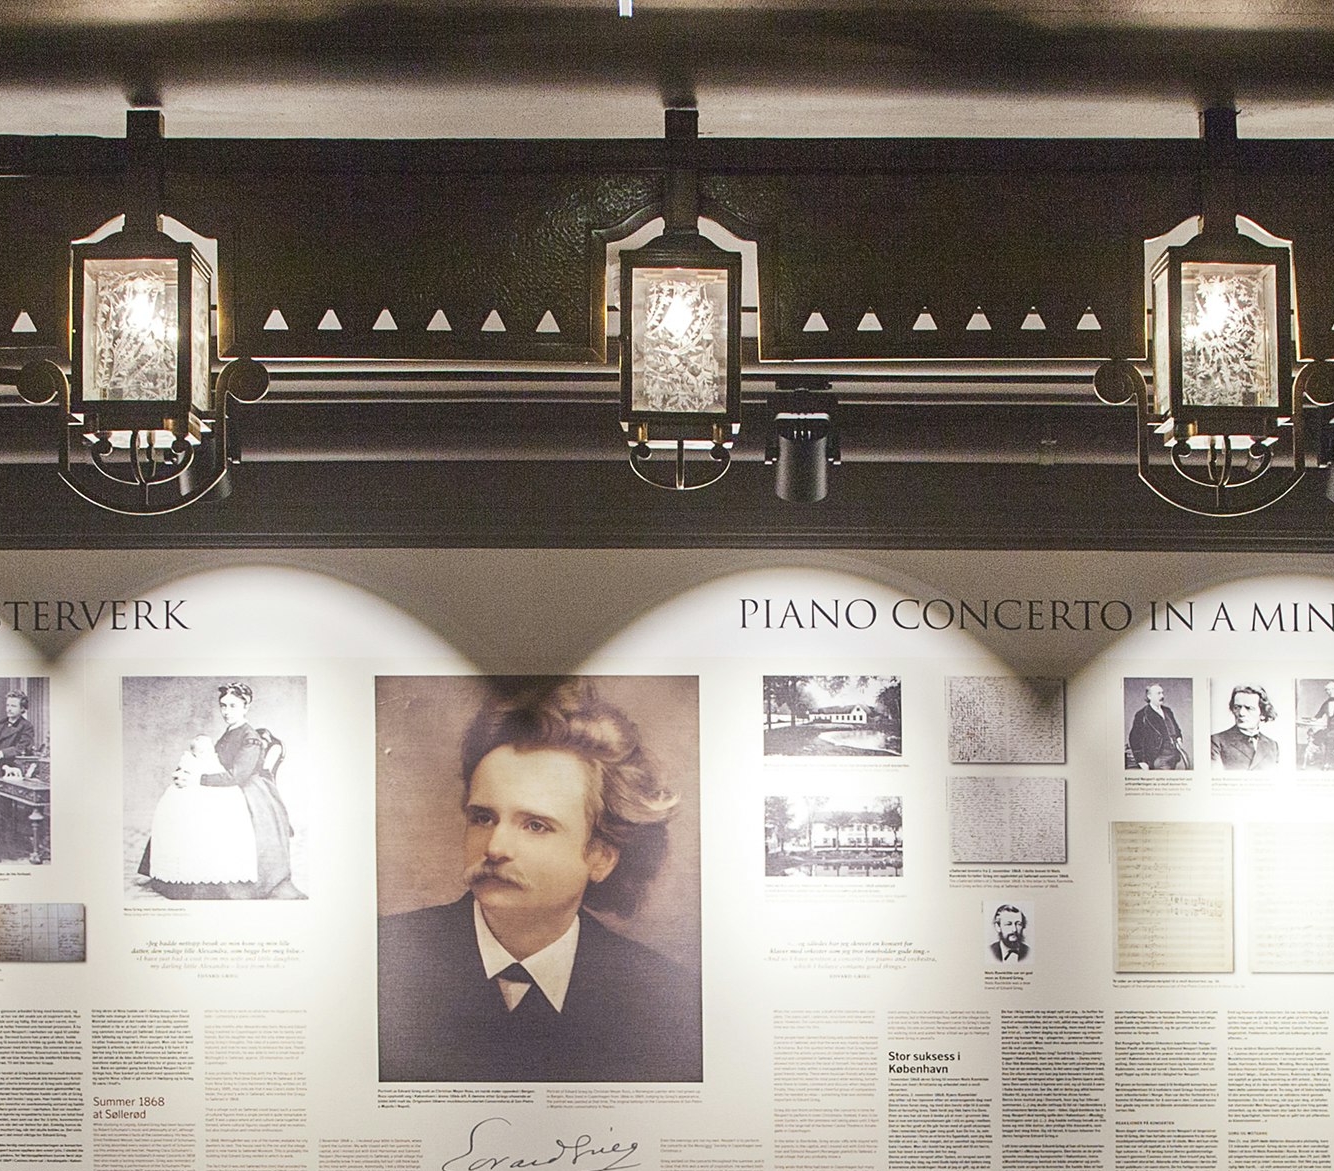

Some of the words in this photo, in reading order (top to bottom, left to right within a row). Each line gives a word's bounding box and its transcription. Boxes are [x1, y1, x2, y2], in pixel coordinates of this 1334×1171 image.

[738, 598, 878, 630] PIANO
[891, 598, 1133, 632] CONCERTO
[1149, 600, 1195, 632] IN
[1210, 601, 1236, 632] A
[888, 1051, 910, 1061] Stor
[913, 1051, 955, 1061] suksess
[888, 1064, 949, 1074] København
[93, 1096, 135, 1107] Summer
[139, 1096, 165, 1107] 1868
[92, 1110, 103, 1119] at
[105, 1109, 147, 1119] Søllerød
